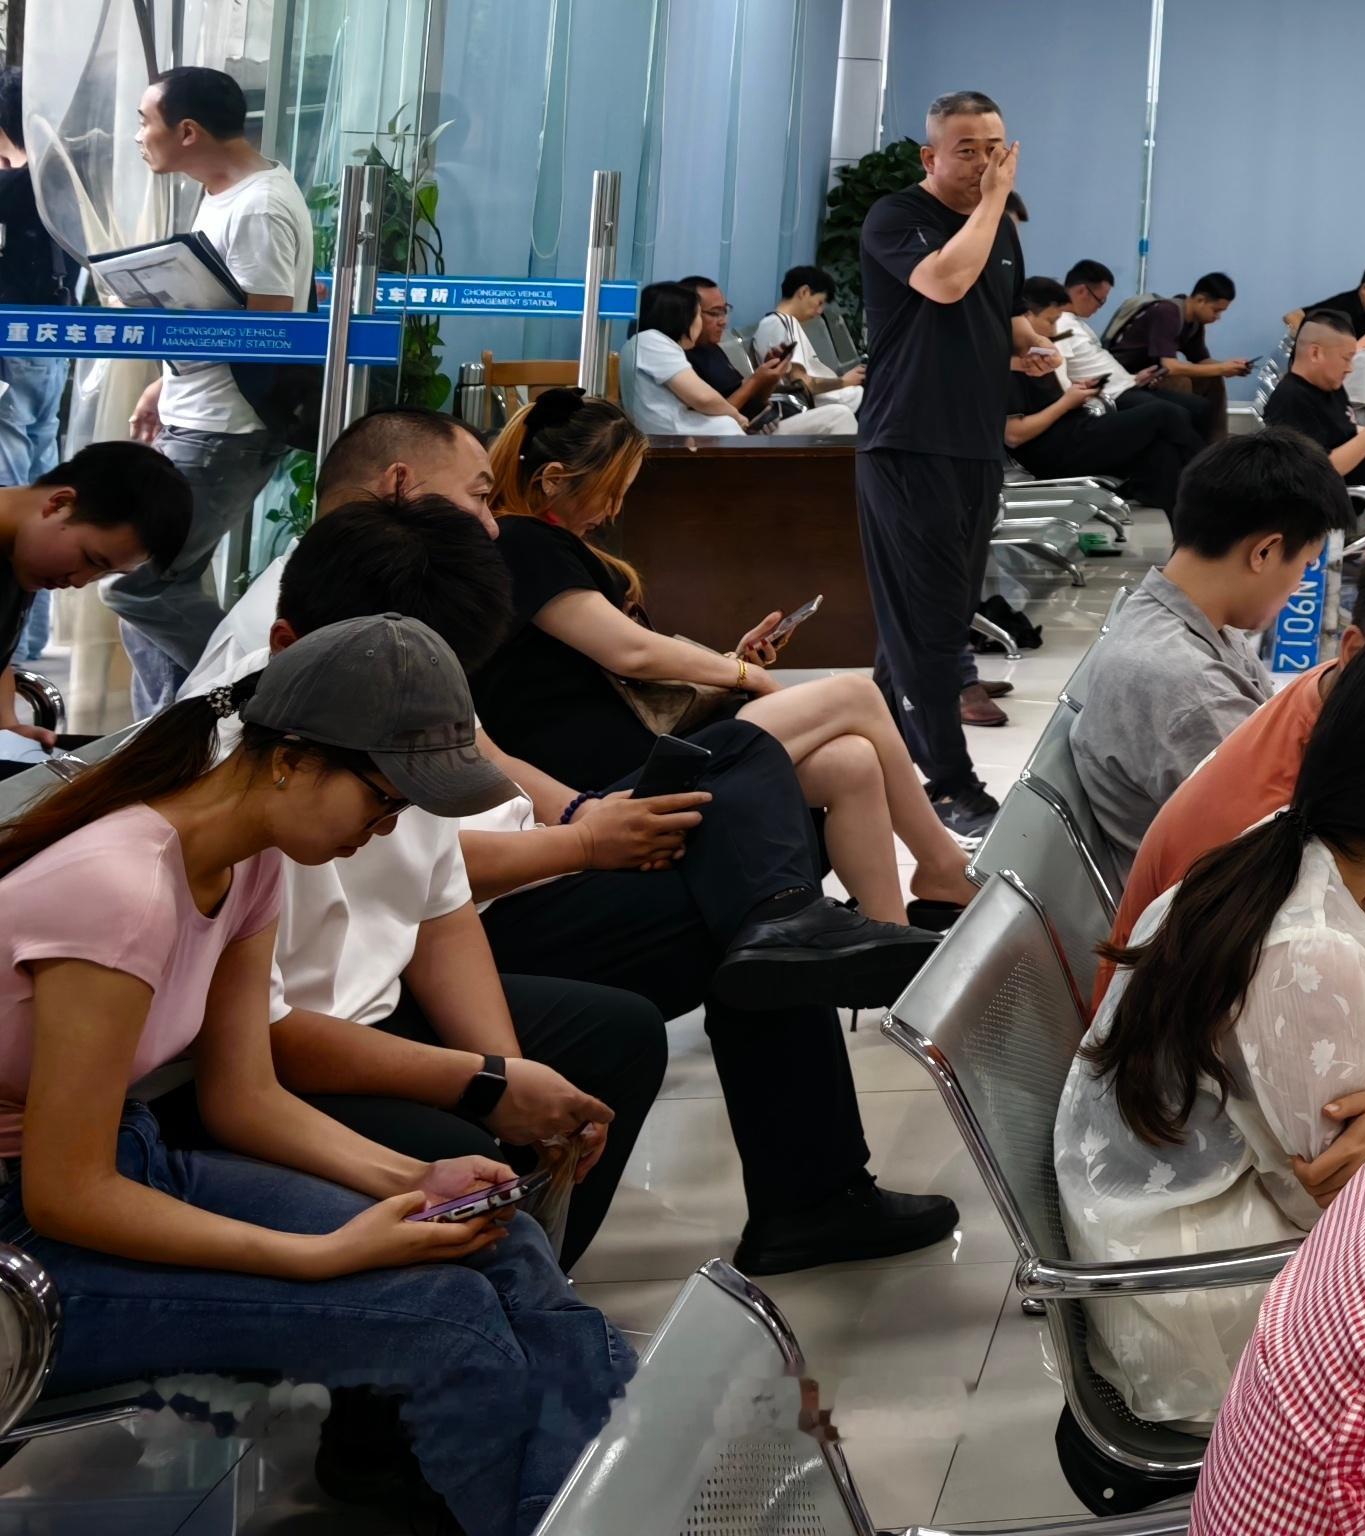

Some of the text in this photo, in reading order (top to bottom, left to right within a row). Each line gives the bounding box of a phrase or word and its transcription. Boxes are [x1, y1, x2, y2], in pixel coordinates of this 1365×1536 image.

[463, 288, 553, 299] CHONGQING VEHICLE
[461, 297, 557, 307] MANAGEMENT STATION
[6, 322, 146, 345] 重庆车管所
[165, 325, 287, 338] CHONGQING VEHICLE
[162, 337, 292, 350] MANAGEMENT STATION
